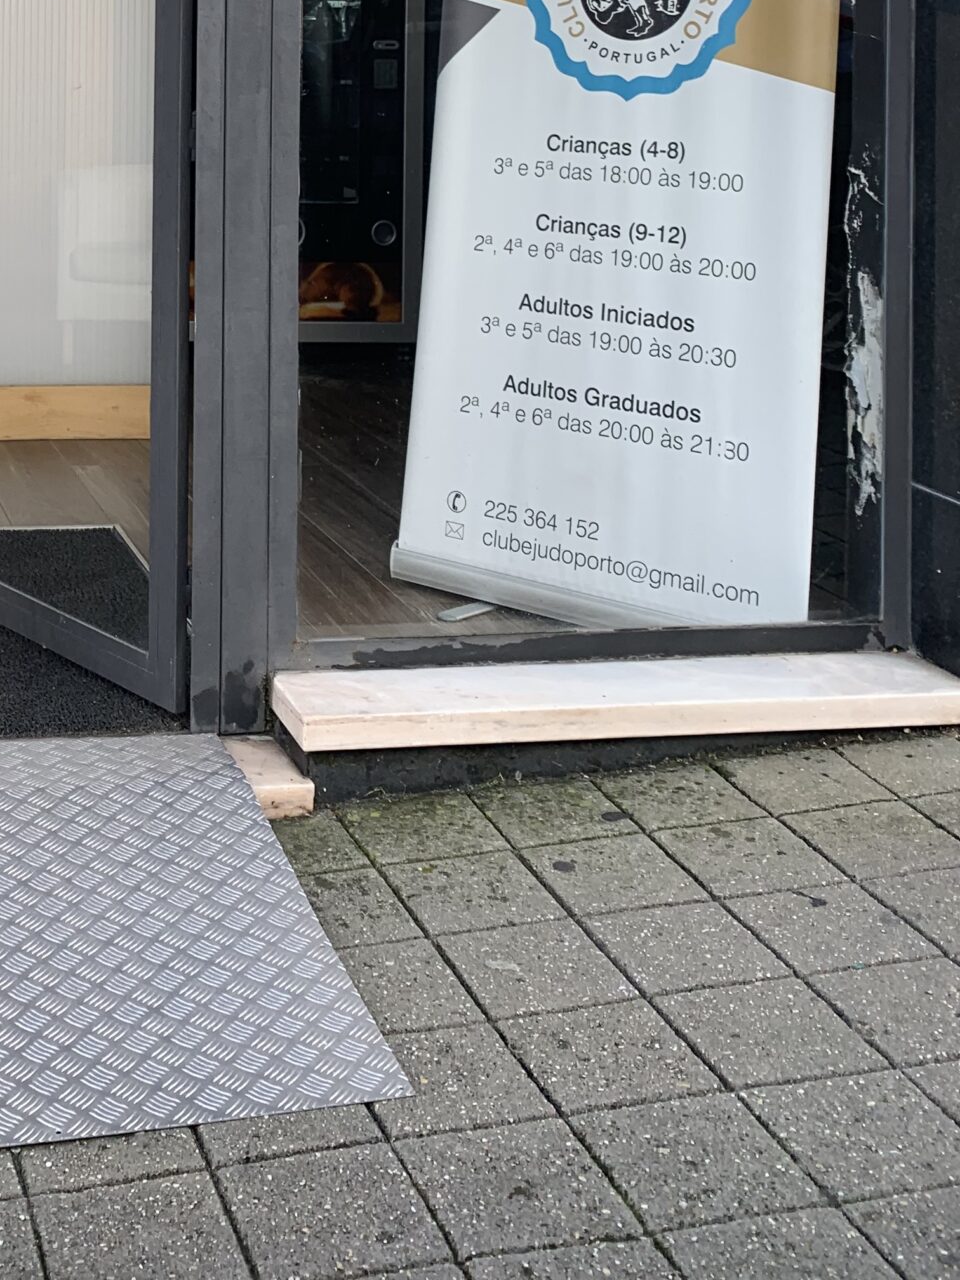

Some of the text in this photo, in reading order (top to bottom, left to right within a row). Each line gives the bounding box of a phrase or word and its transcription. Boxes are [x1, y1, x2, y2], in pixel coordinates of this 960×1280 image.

[588, 40, 681, 64] PORTUGAL
[546, 134, 686, 164] Crianças (4-8)
[493, 157, 744, 192] 3ª e 5ª das 18:00 às 19:00
[535, 214, 687, 249] Crianças (9-12)
[473, 234, 757, 281] 2ª, 4ª e 6ª das 19:00 às 20:00
[518, 293, 695, 332] Adultos Iniciados
[480, 316, 737, 368] 3ª e 5ª das 19:00 às 20:30
[503, 374, 701, 423] Adultos Graduados
[460, 395, 750, 461] 2ª, 4ª e 6ª das 20:00 às 21:30
[483, 500, 600, 541] 225 364 152
[482, 530, 760, 607] clubejudoporto@gmail.com
